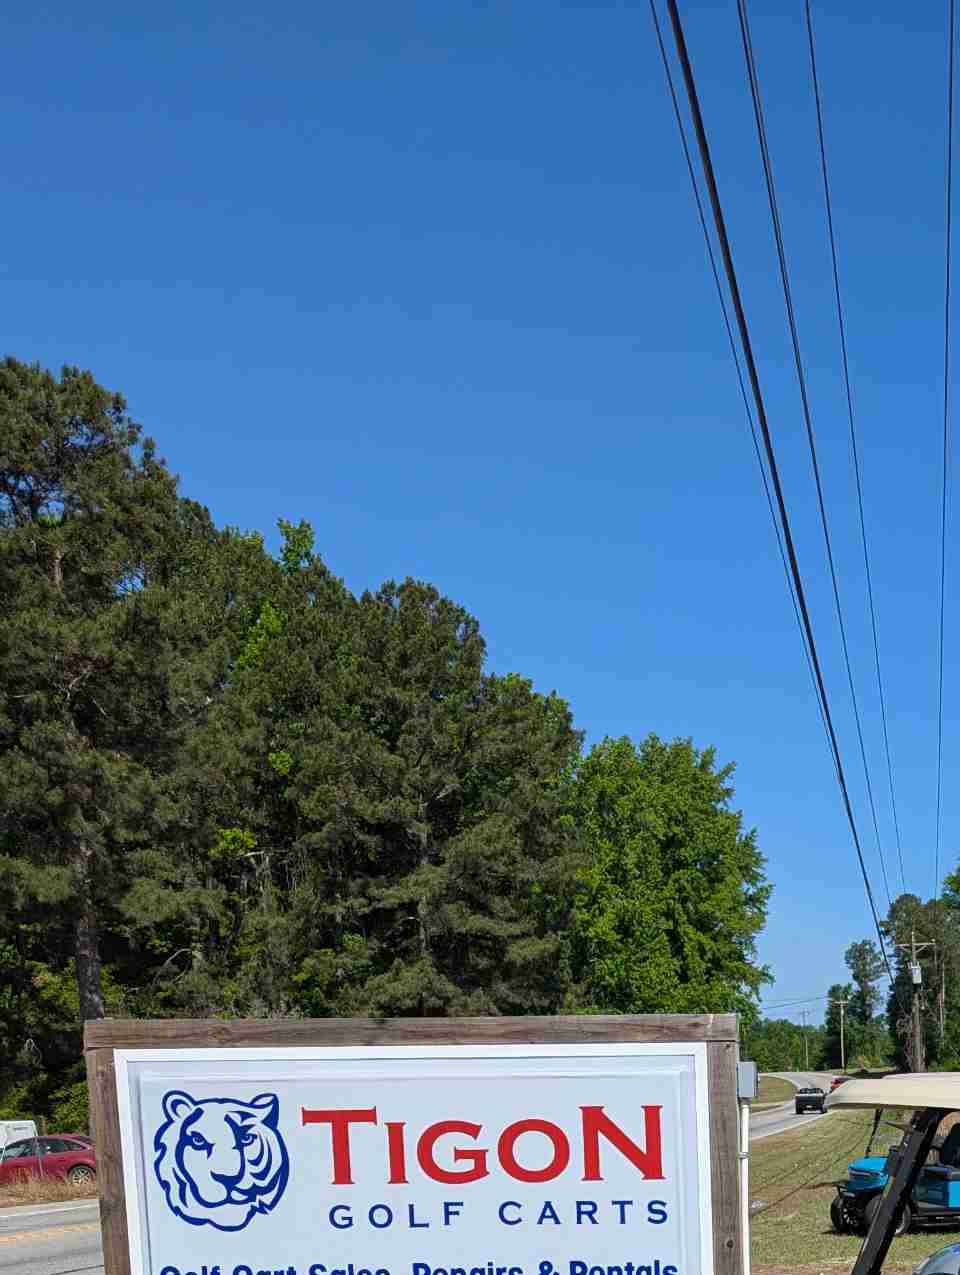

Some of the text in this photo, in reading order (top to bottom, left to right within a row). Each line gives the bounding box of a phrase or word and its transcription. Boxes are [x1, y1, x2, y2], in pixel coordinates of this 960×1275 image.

[302, 1103, 667, 1185] TIGON
[328, 1199, 669, 1230] GOLF CARTS
